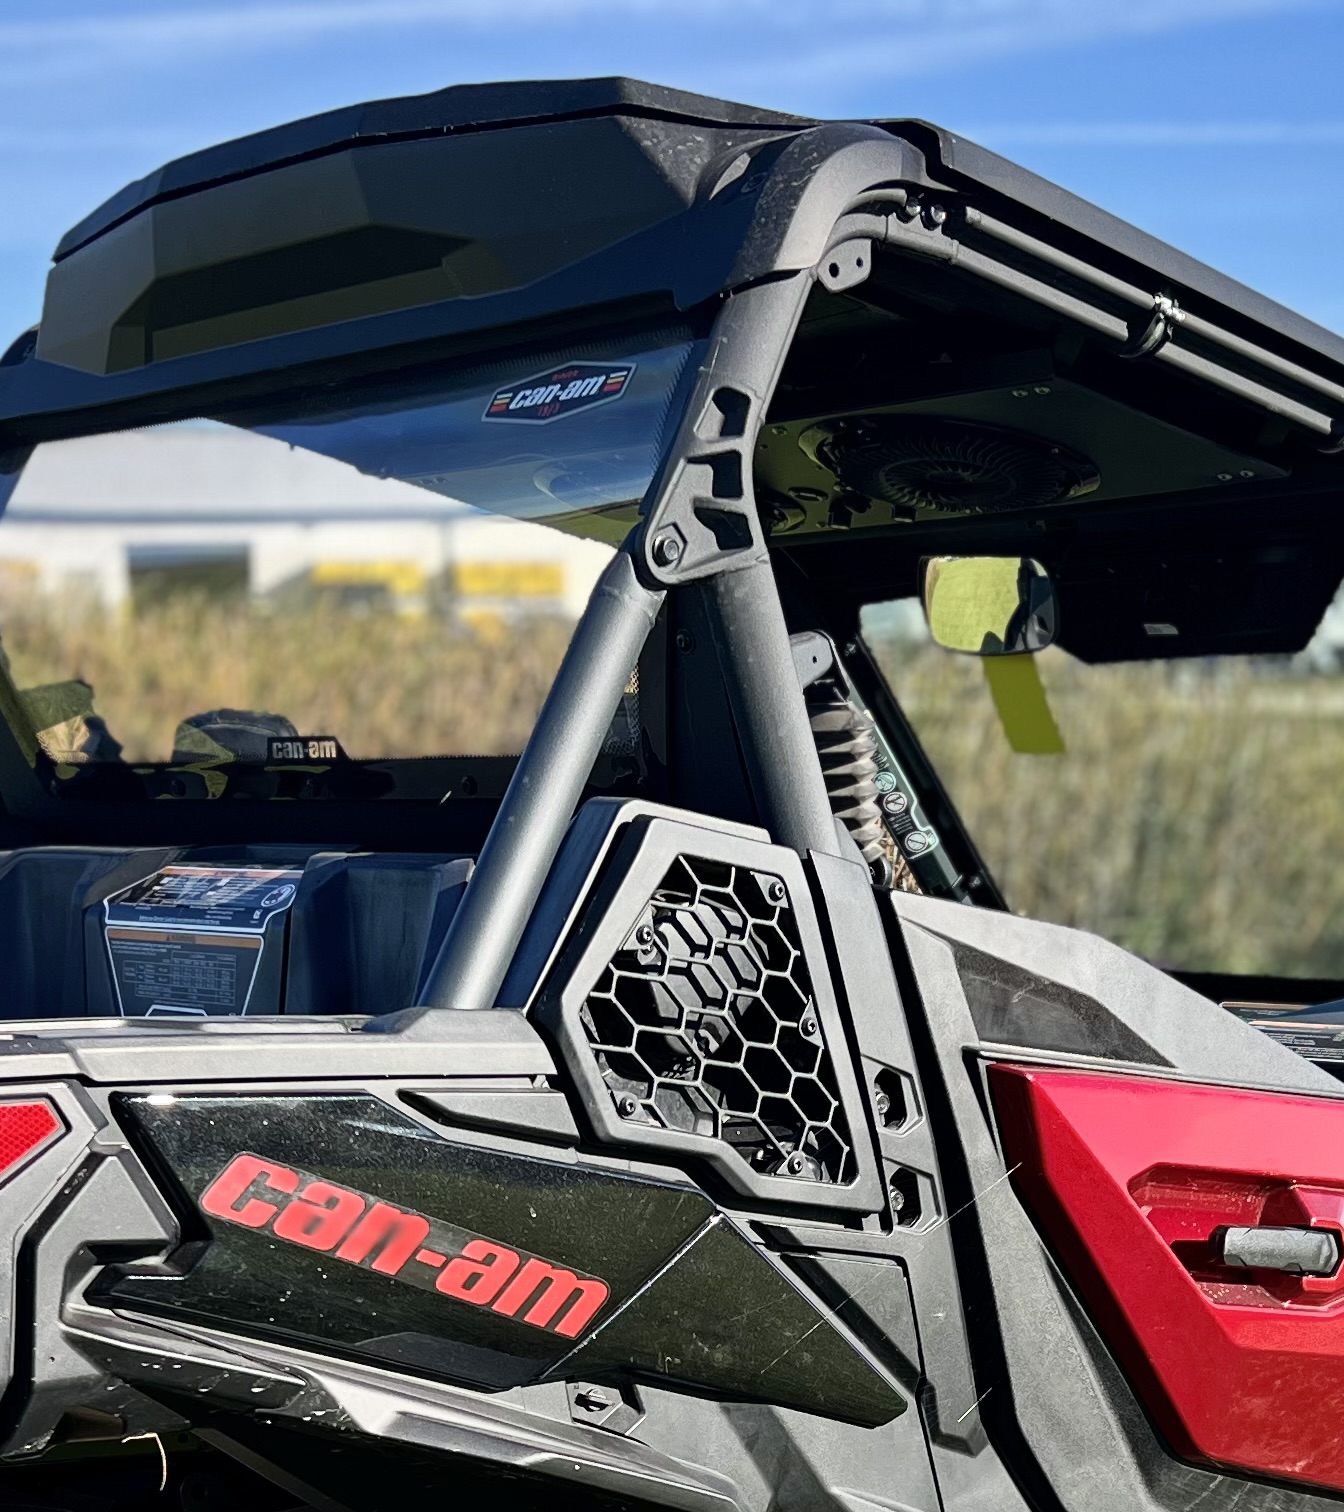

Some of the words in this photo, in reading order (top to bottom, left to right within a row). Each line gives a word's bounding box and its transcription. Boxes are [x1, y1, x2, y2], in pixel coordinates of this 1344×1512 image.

[508, 374, 606, 410] can-am
[272, 740, 337, 759] can-am
[200, 1153, 610, 1339] can-am
